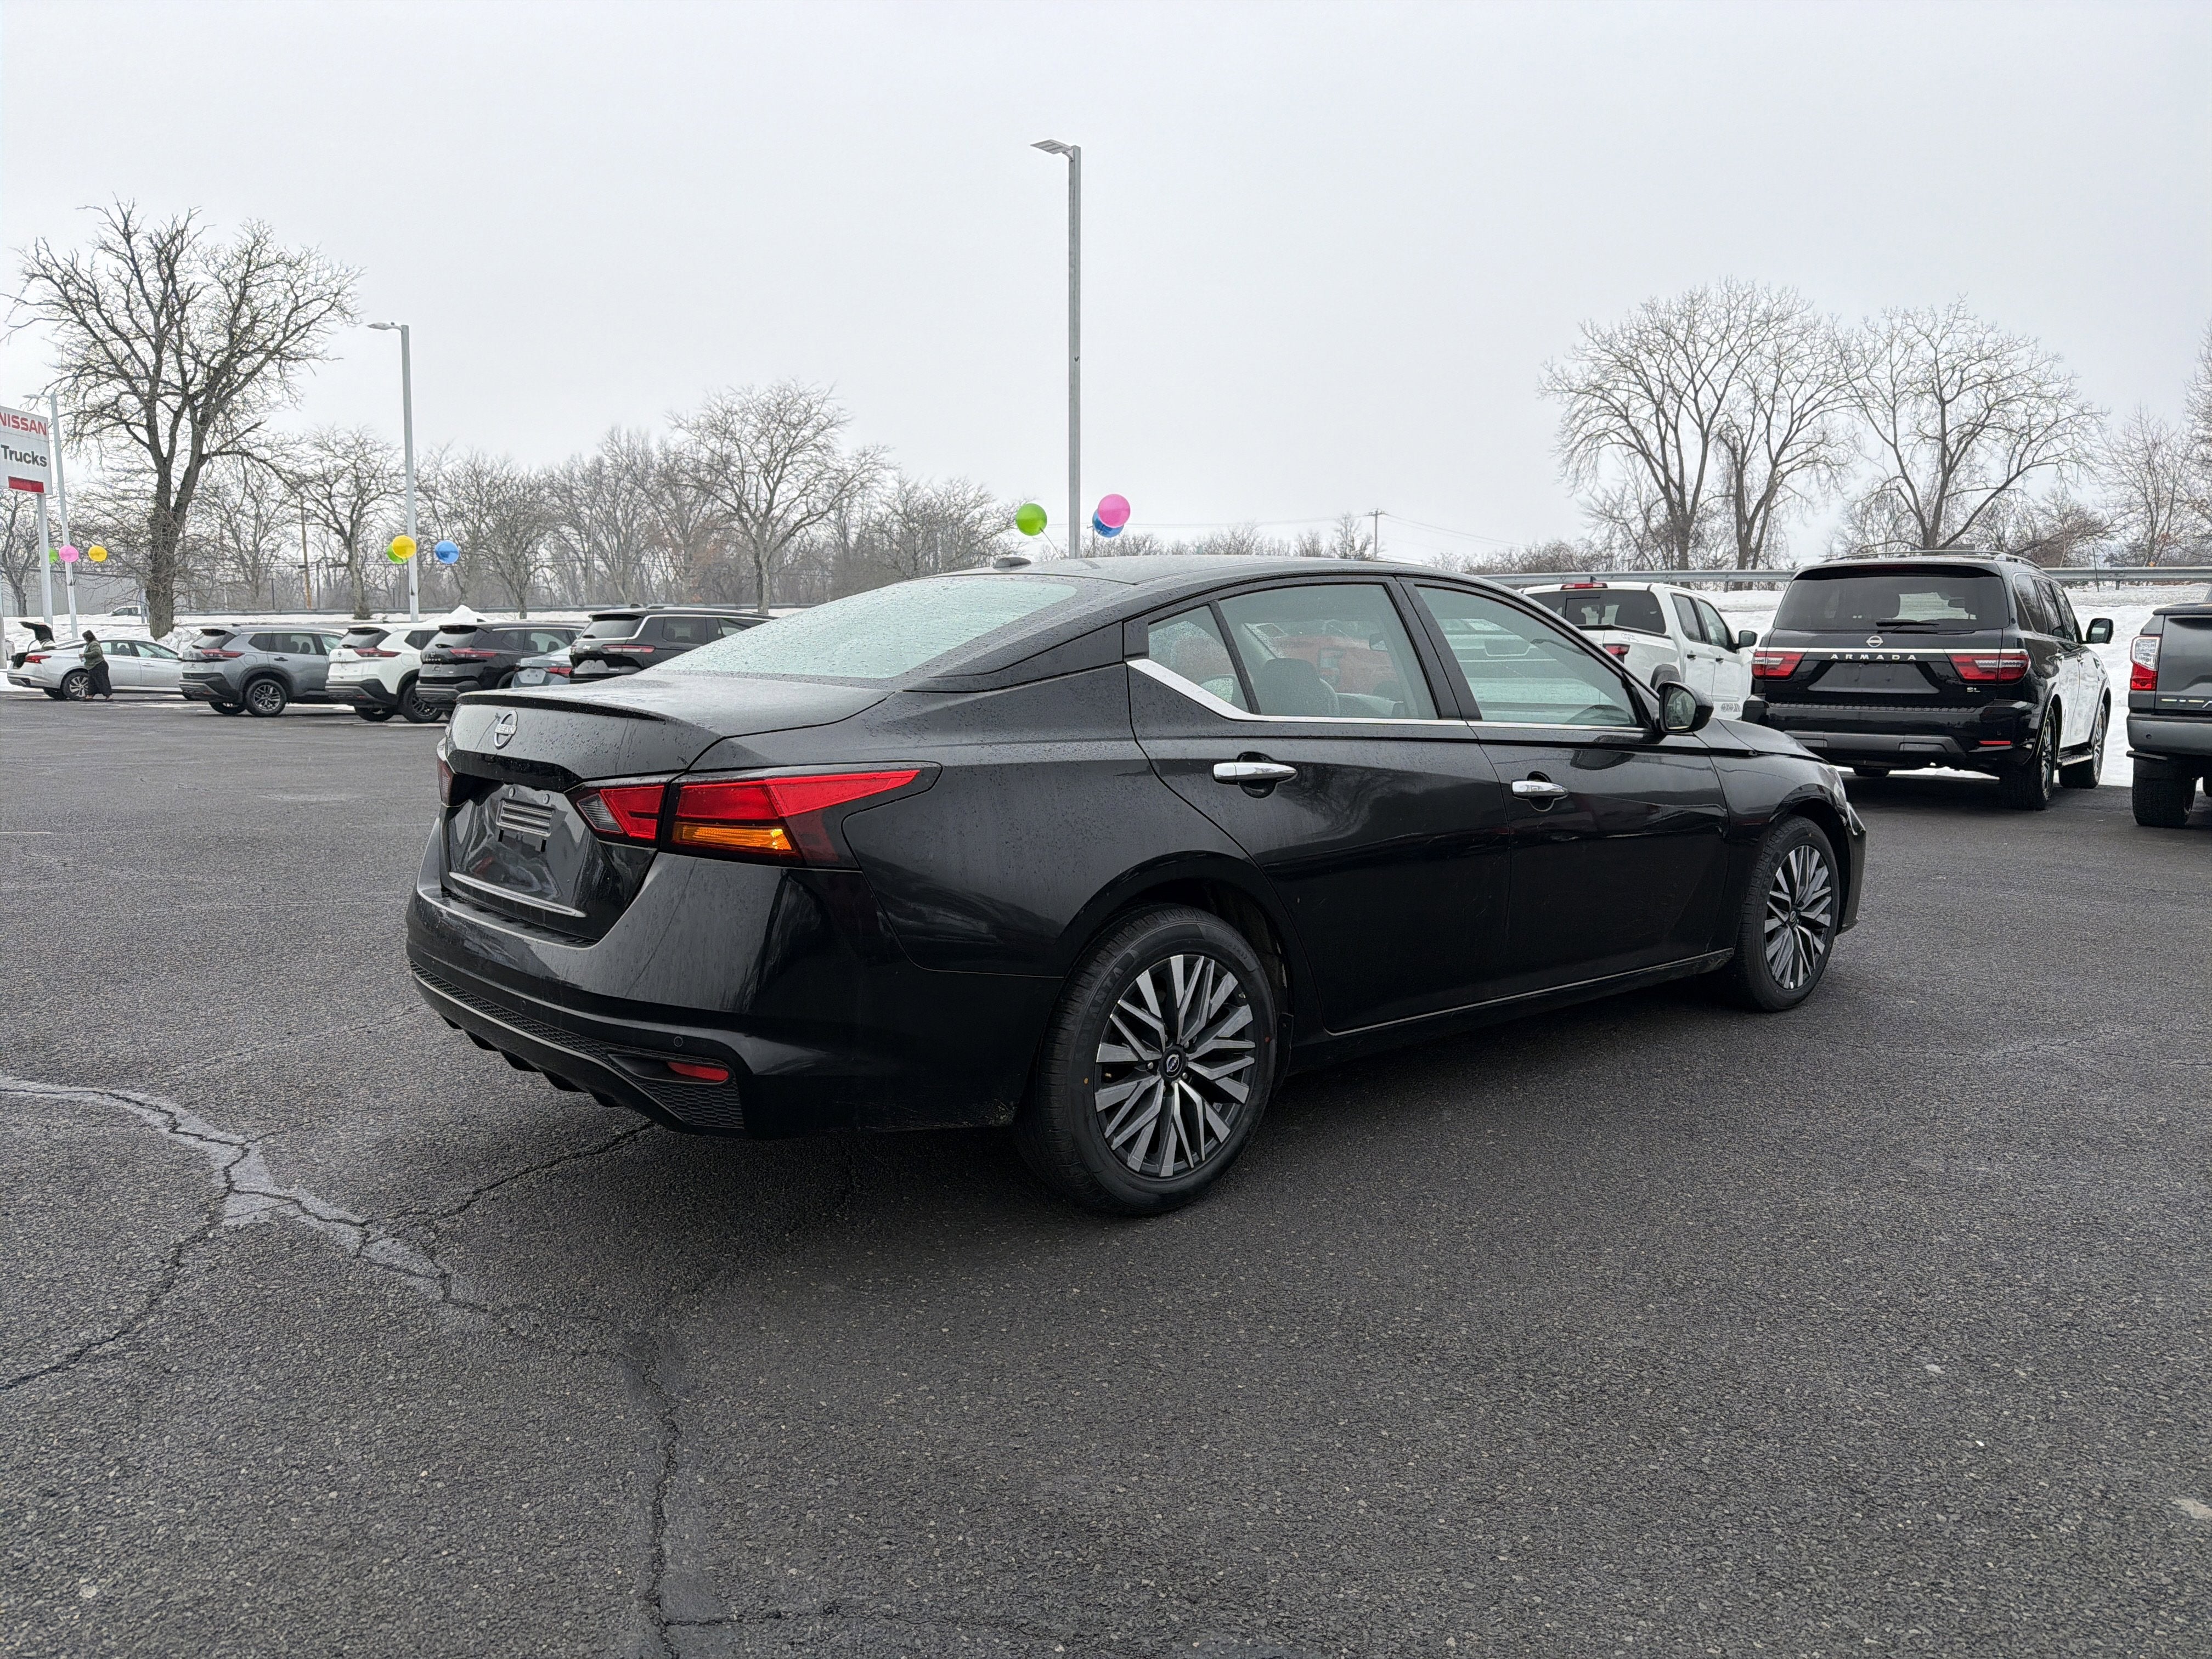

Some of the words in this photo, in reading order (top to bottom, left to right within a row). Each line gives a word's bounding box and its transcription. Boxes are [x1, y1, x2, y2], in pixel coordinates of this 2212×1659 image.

[0, 412, 47, 436] NISSAN
[1, 444, 47, 467] Trucks
[495, 725, 516, 734] SSAN
